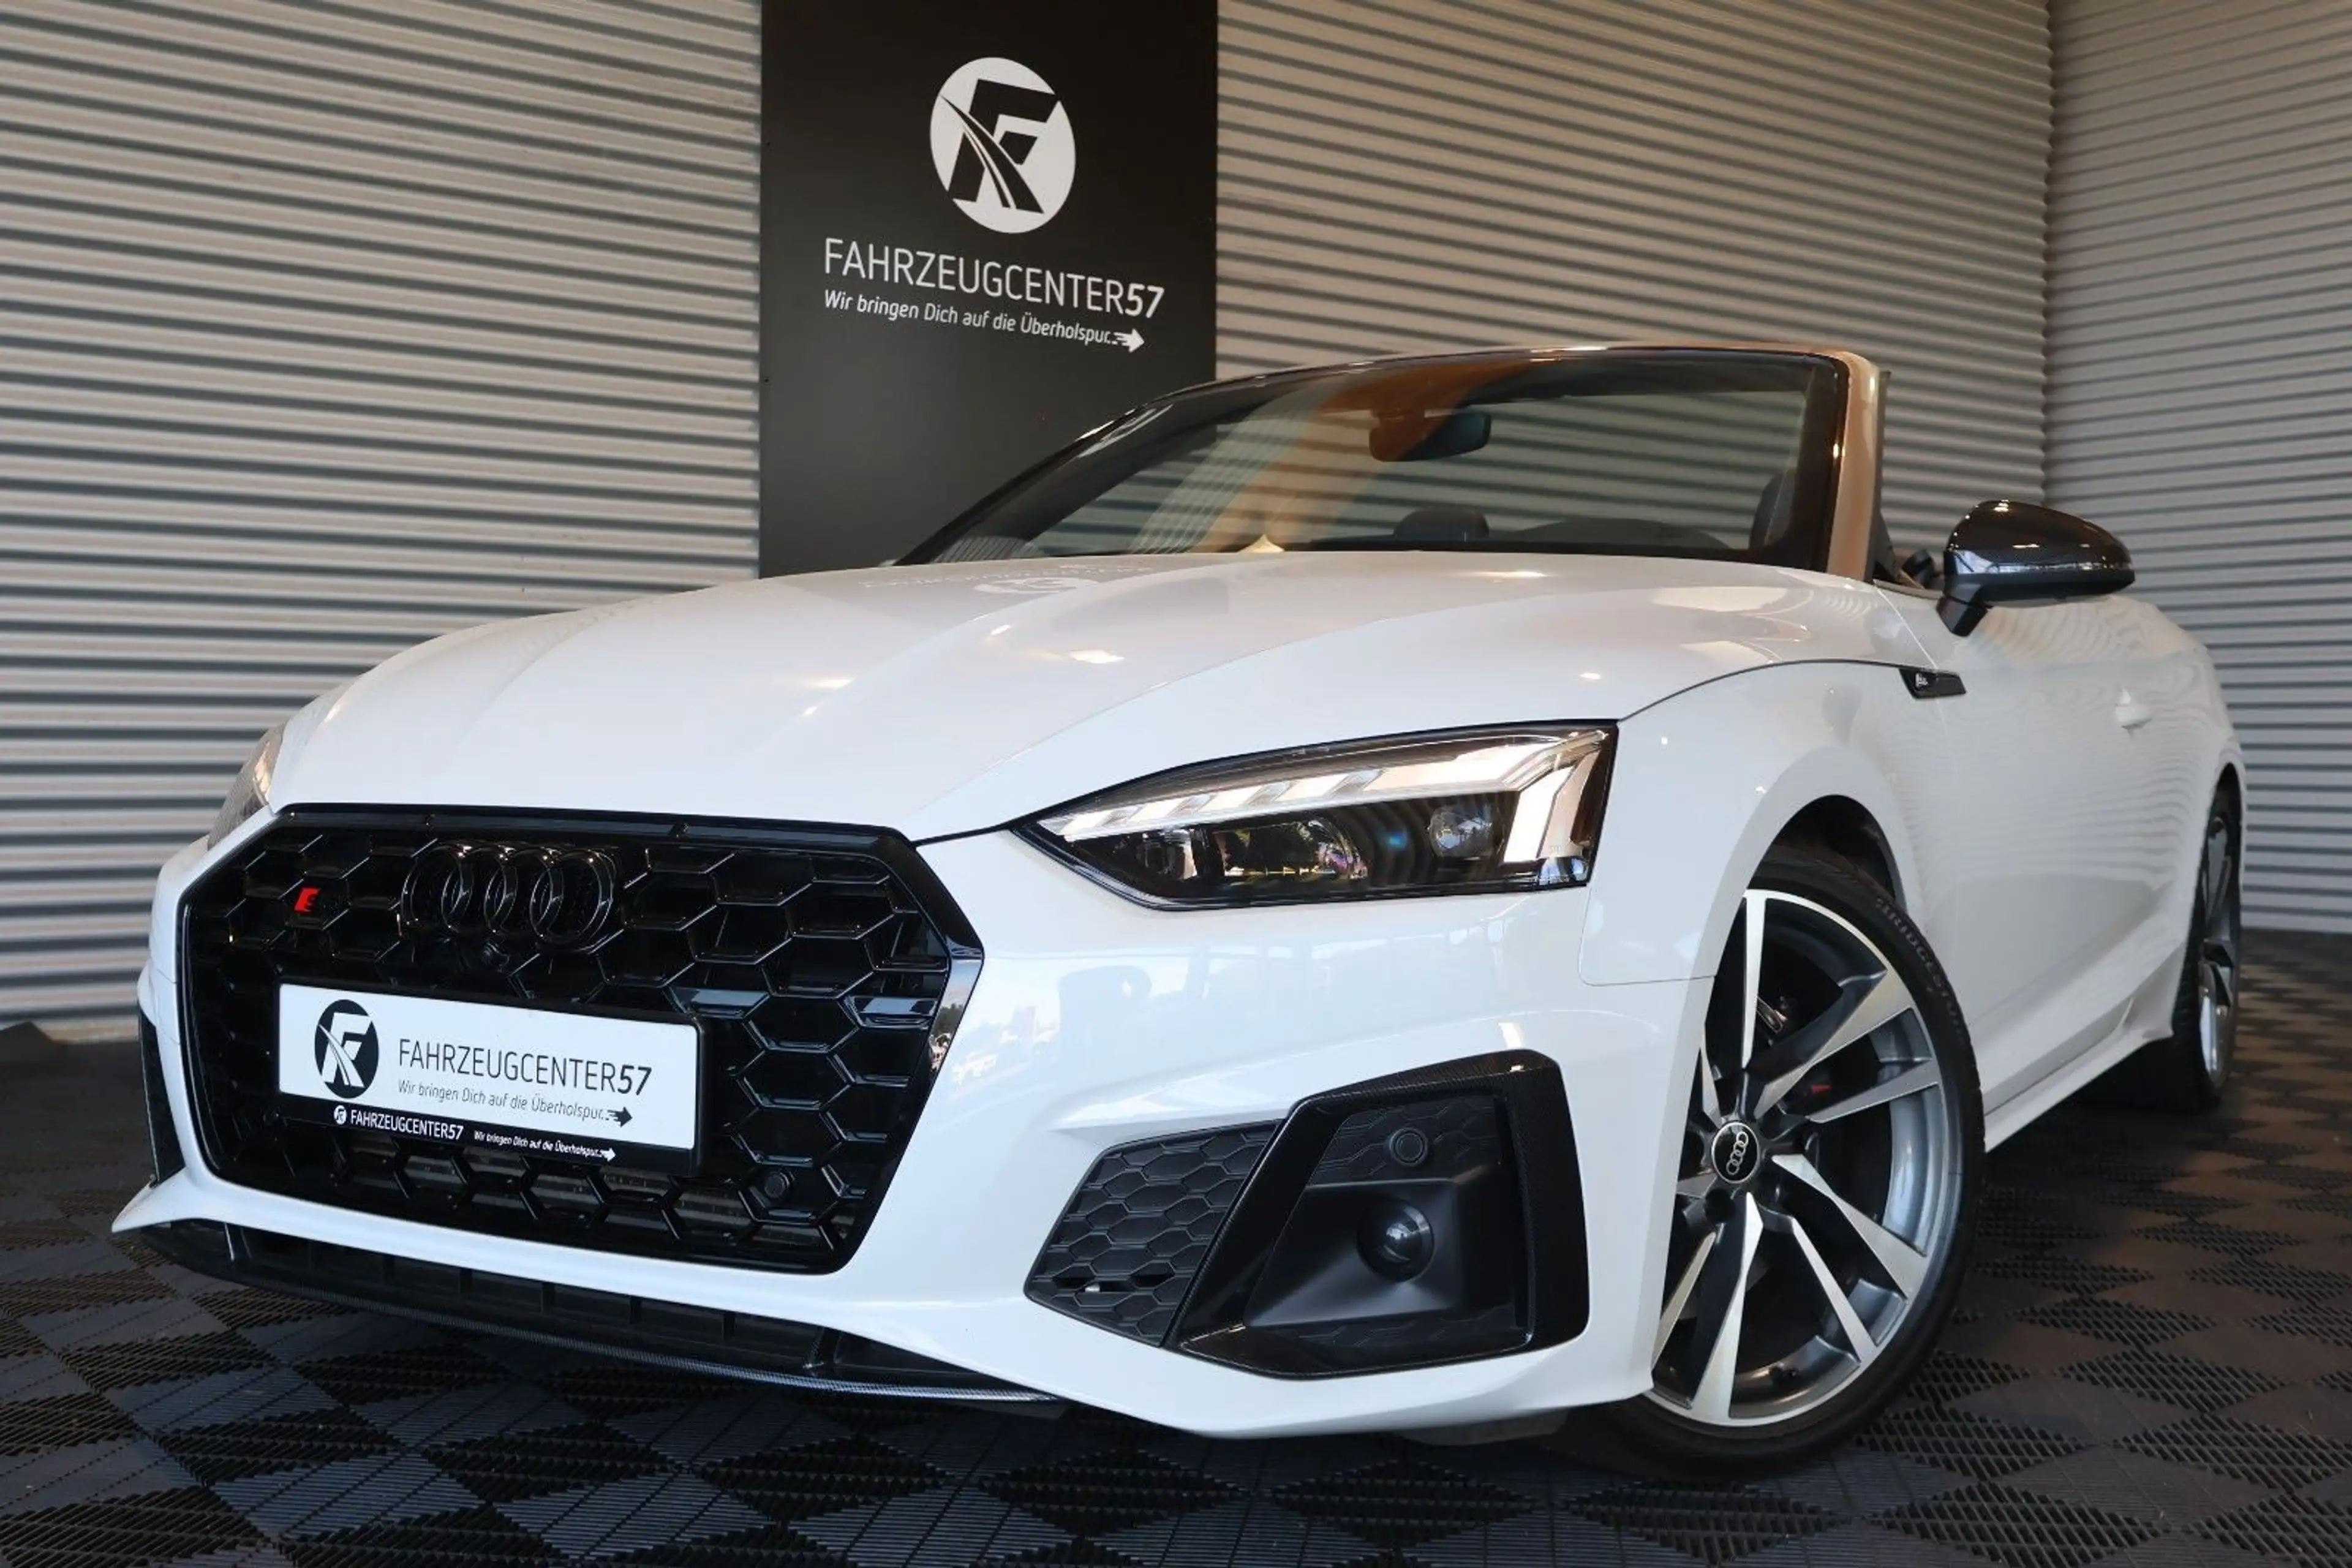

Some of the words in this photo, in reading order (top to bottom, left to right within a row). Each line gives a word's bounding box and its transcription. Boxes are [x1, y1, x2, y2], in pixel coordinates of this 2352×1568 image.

[825, 238, 1164, 318] FAHRZEUGCENTER57
[825, 290, 853, 309] Wir
[858, 294, 919, 321] bringen
[924, 303, 958, 323] Dich
[962, 311, 989, 328] auf
[993, 313, 1016, 331] die
[399, 1039, 652, 1095] FAHRZEUGCENTER57
[399, 1079, 415, 1094] Wir
[418, 1082, 460, 1102] bringen
[462, 1087, 486, 1104] Dich
[489, 1093, 508, 1107] auf
[510, 1094, 527, 1110] die
[350, 1109, 464, 1140] FAHRZEUGCENTER57
